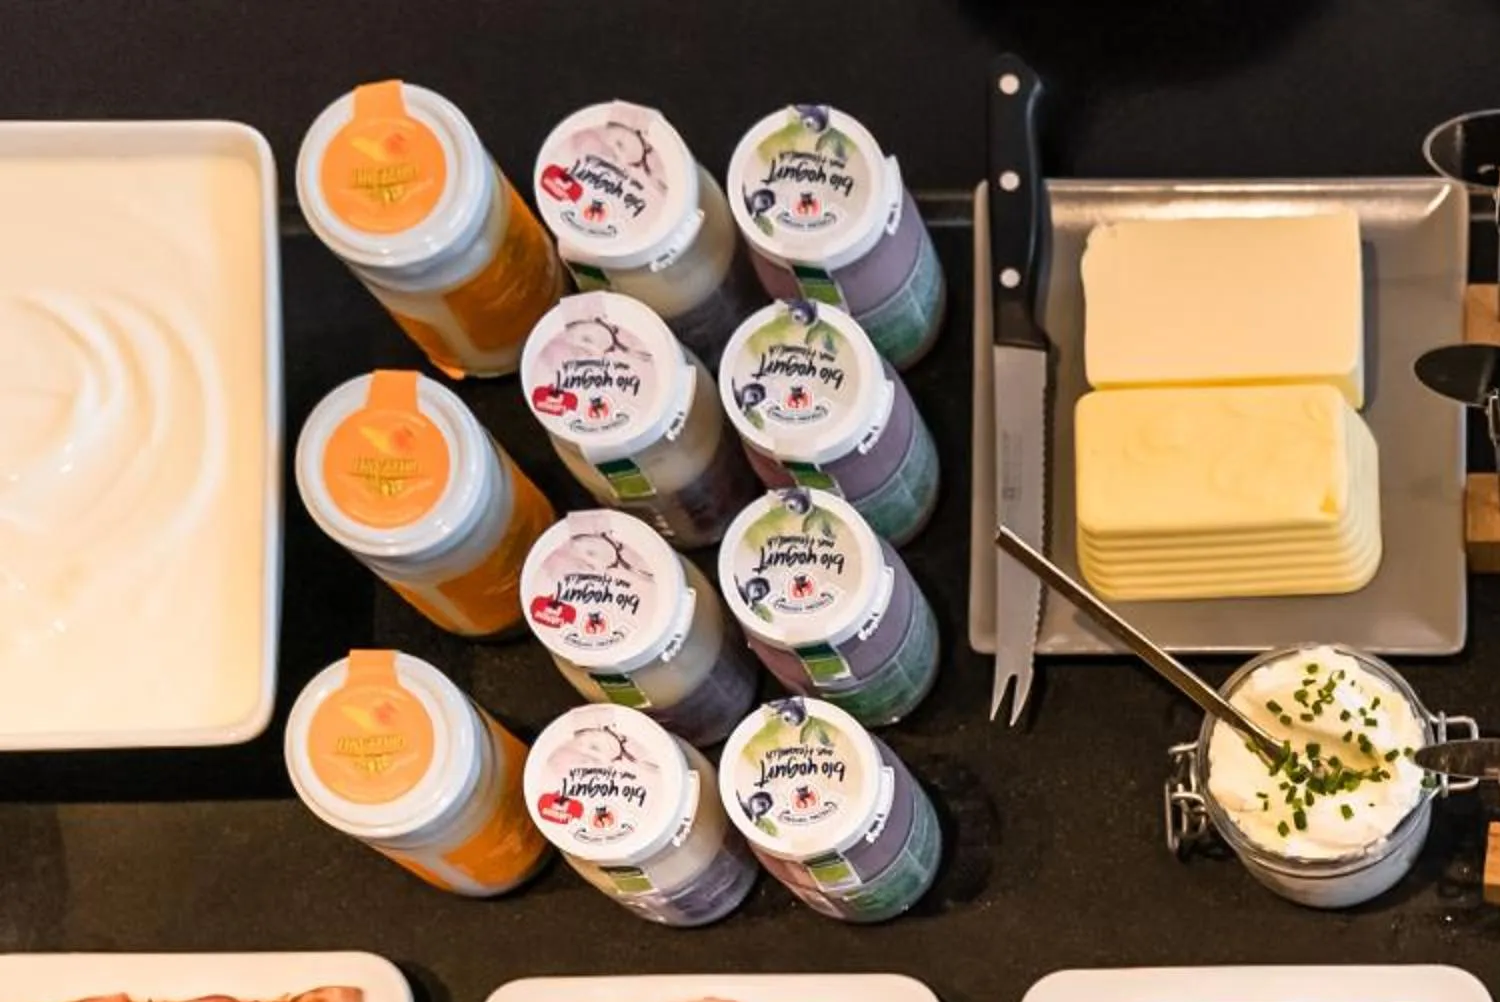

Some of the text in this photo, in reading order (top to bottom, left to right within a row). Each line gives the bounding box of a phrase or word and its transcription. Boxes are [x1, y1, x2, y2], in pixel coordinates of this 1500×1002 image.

[829, 173, 854, 197] bio
[616, 375, 641, 396] bio
[820, 367, 845, 390] bio
[820, 553, 845, 575] bio
[616, 593, 640, 615] bio
[821, 761, 846, 783] bio
[622, 786, 647, 807] bio
